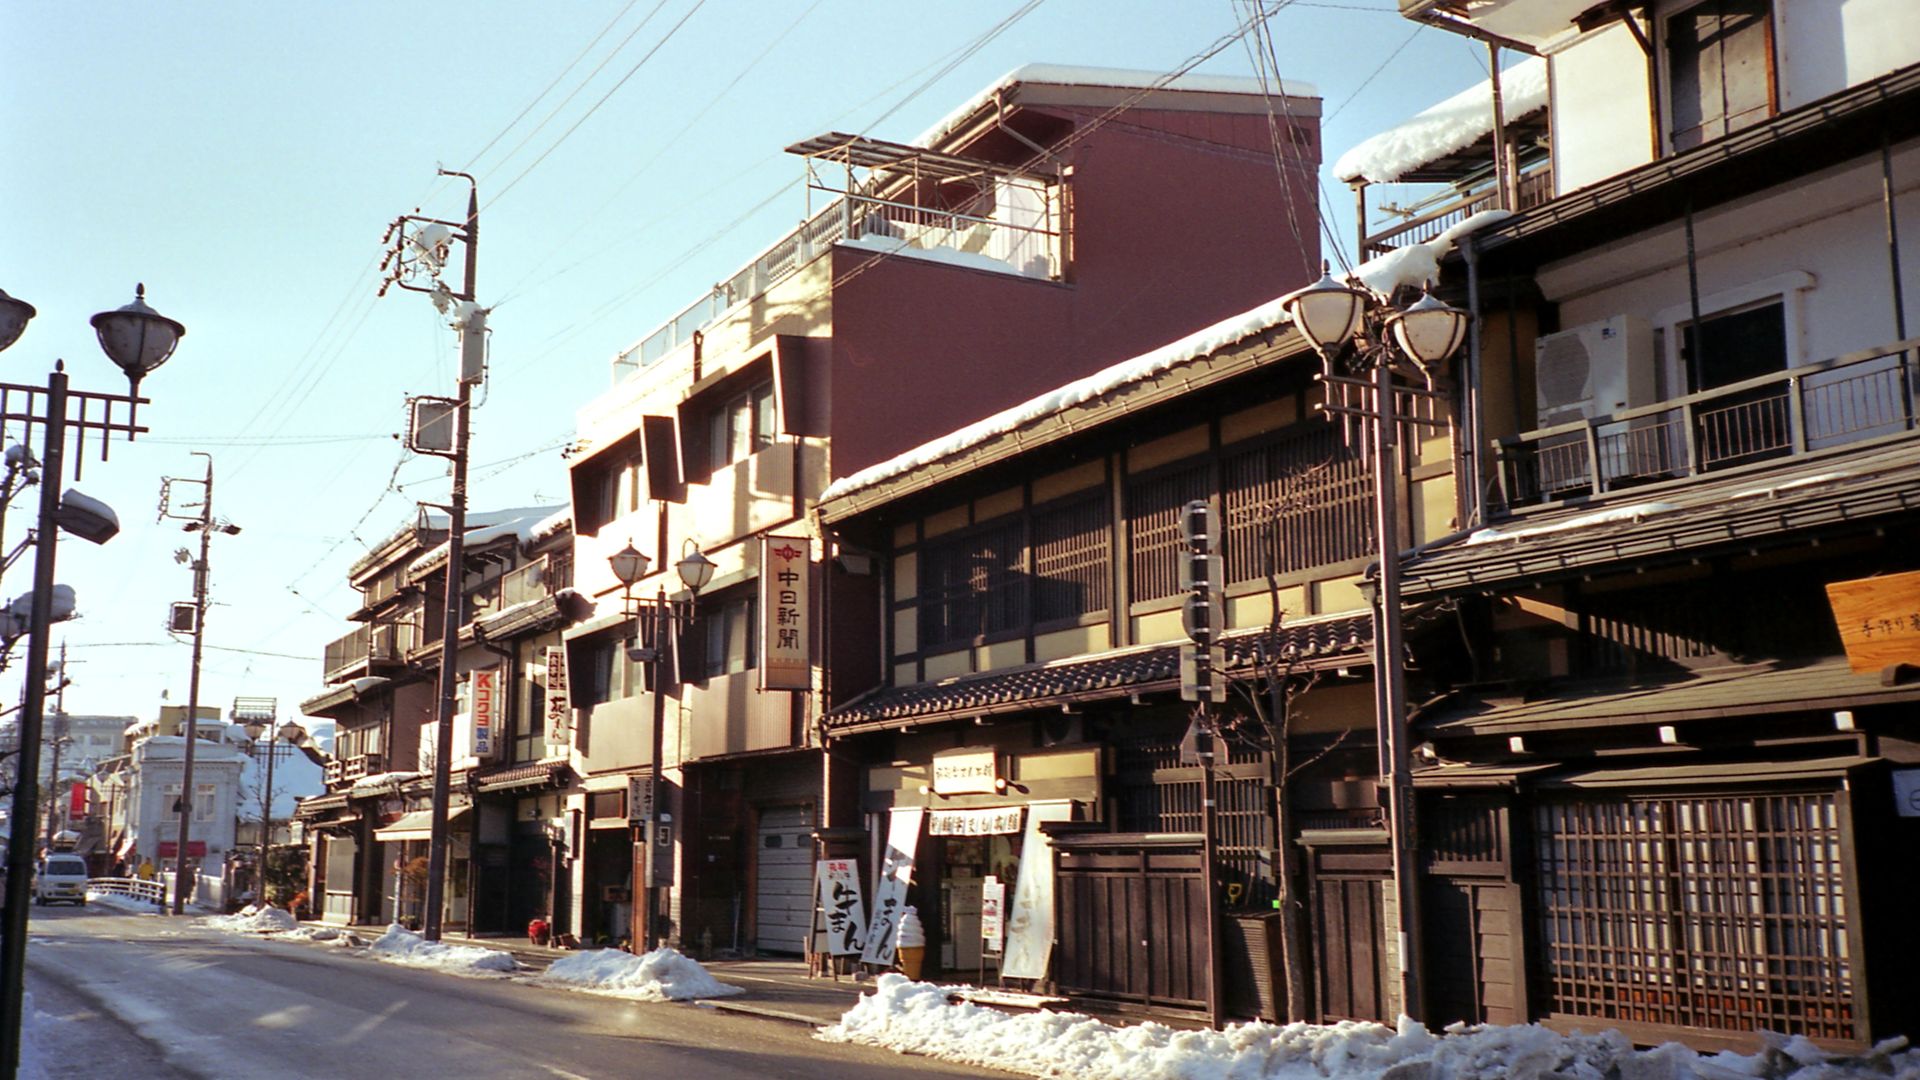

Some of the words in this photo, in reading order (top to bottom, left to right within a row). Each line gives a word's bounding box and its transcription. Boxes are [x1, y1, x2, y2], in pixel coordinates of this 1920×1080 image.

[776, 567, 800, 650] 中日新聞
[828, 881, 865, 952] 牛まん
